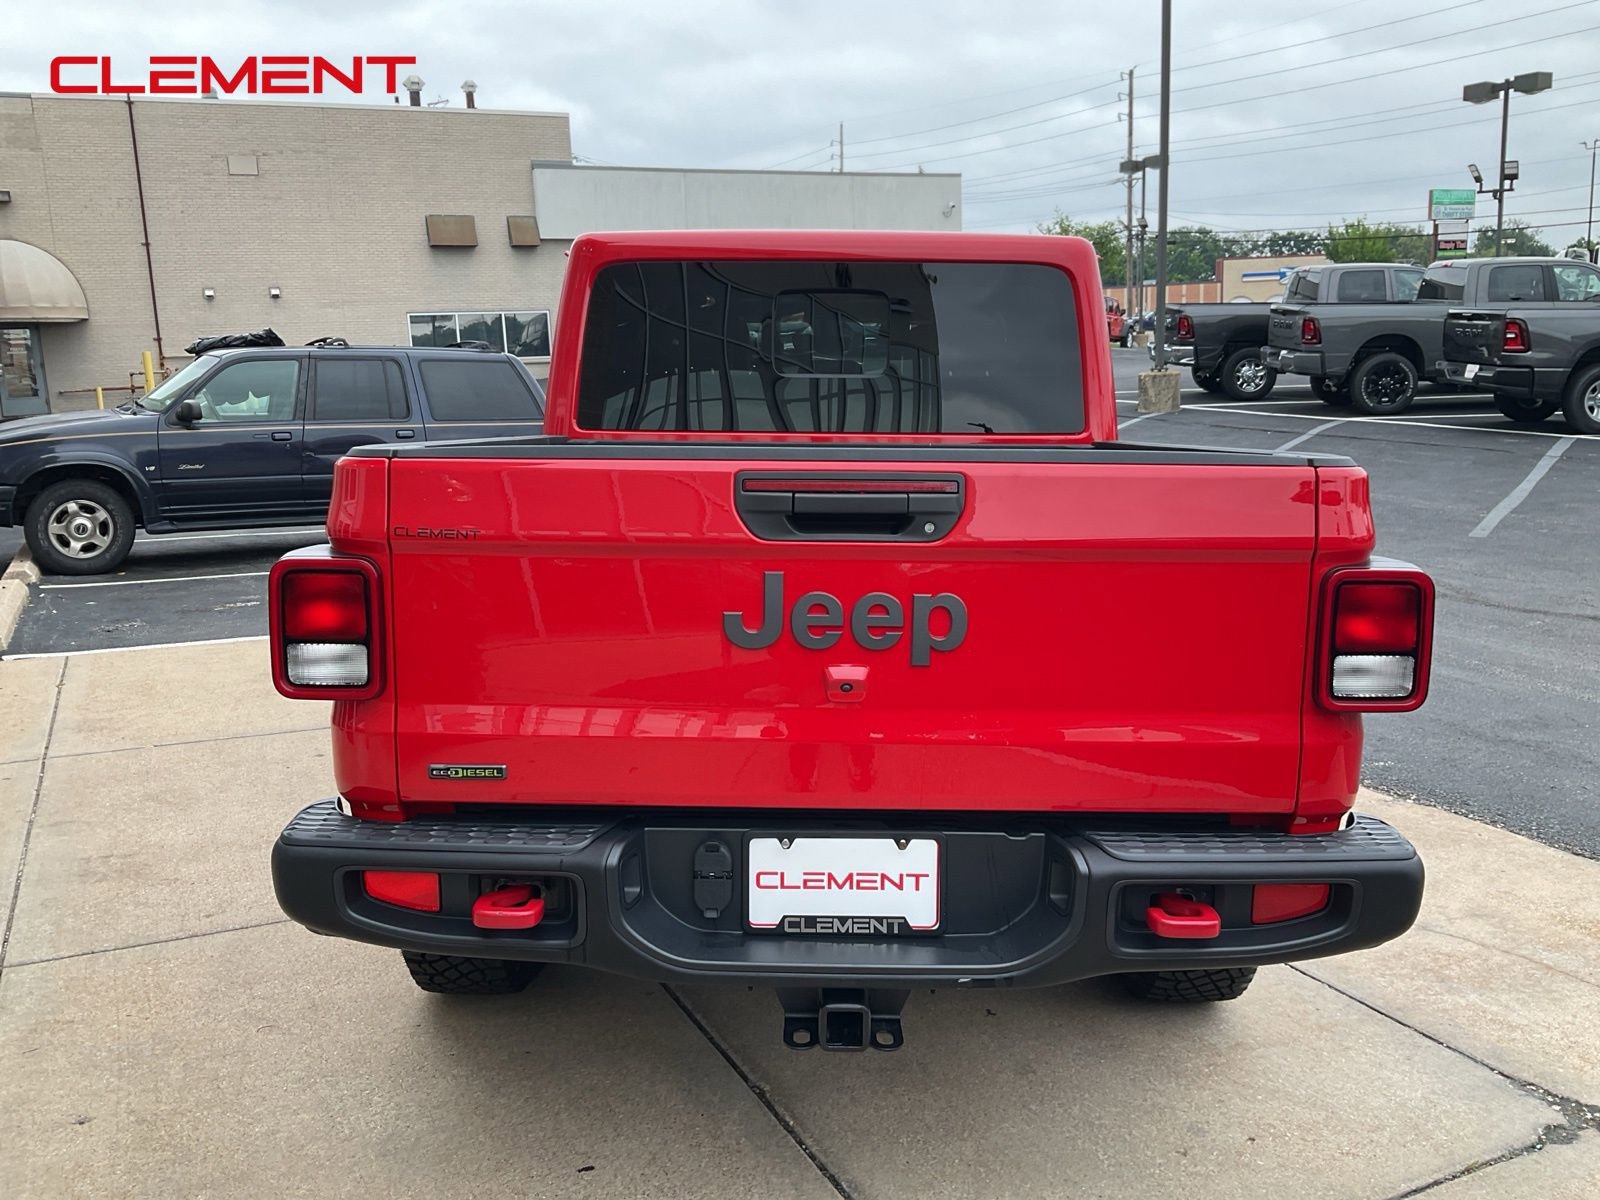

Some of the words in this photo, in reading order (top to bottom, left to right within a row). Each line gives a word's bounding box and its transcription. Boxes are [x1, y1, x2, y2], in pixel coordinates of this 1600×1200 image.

[394, 526, 480, 540] CLEMENT
[722, 570, 969, 667] Jeep
[755, 871, 930, 892] CLEMENT
[783, 916, 905, 935] CLEMENT
